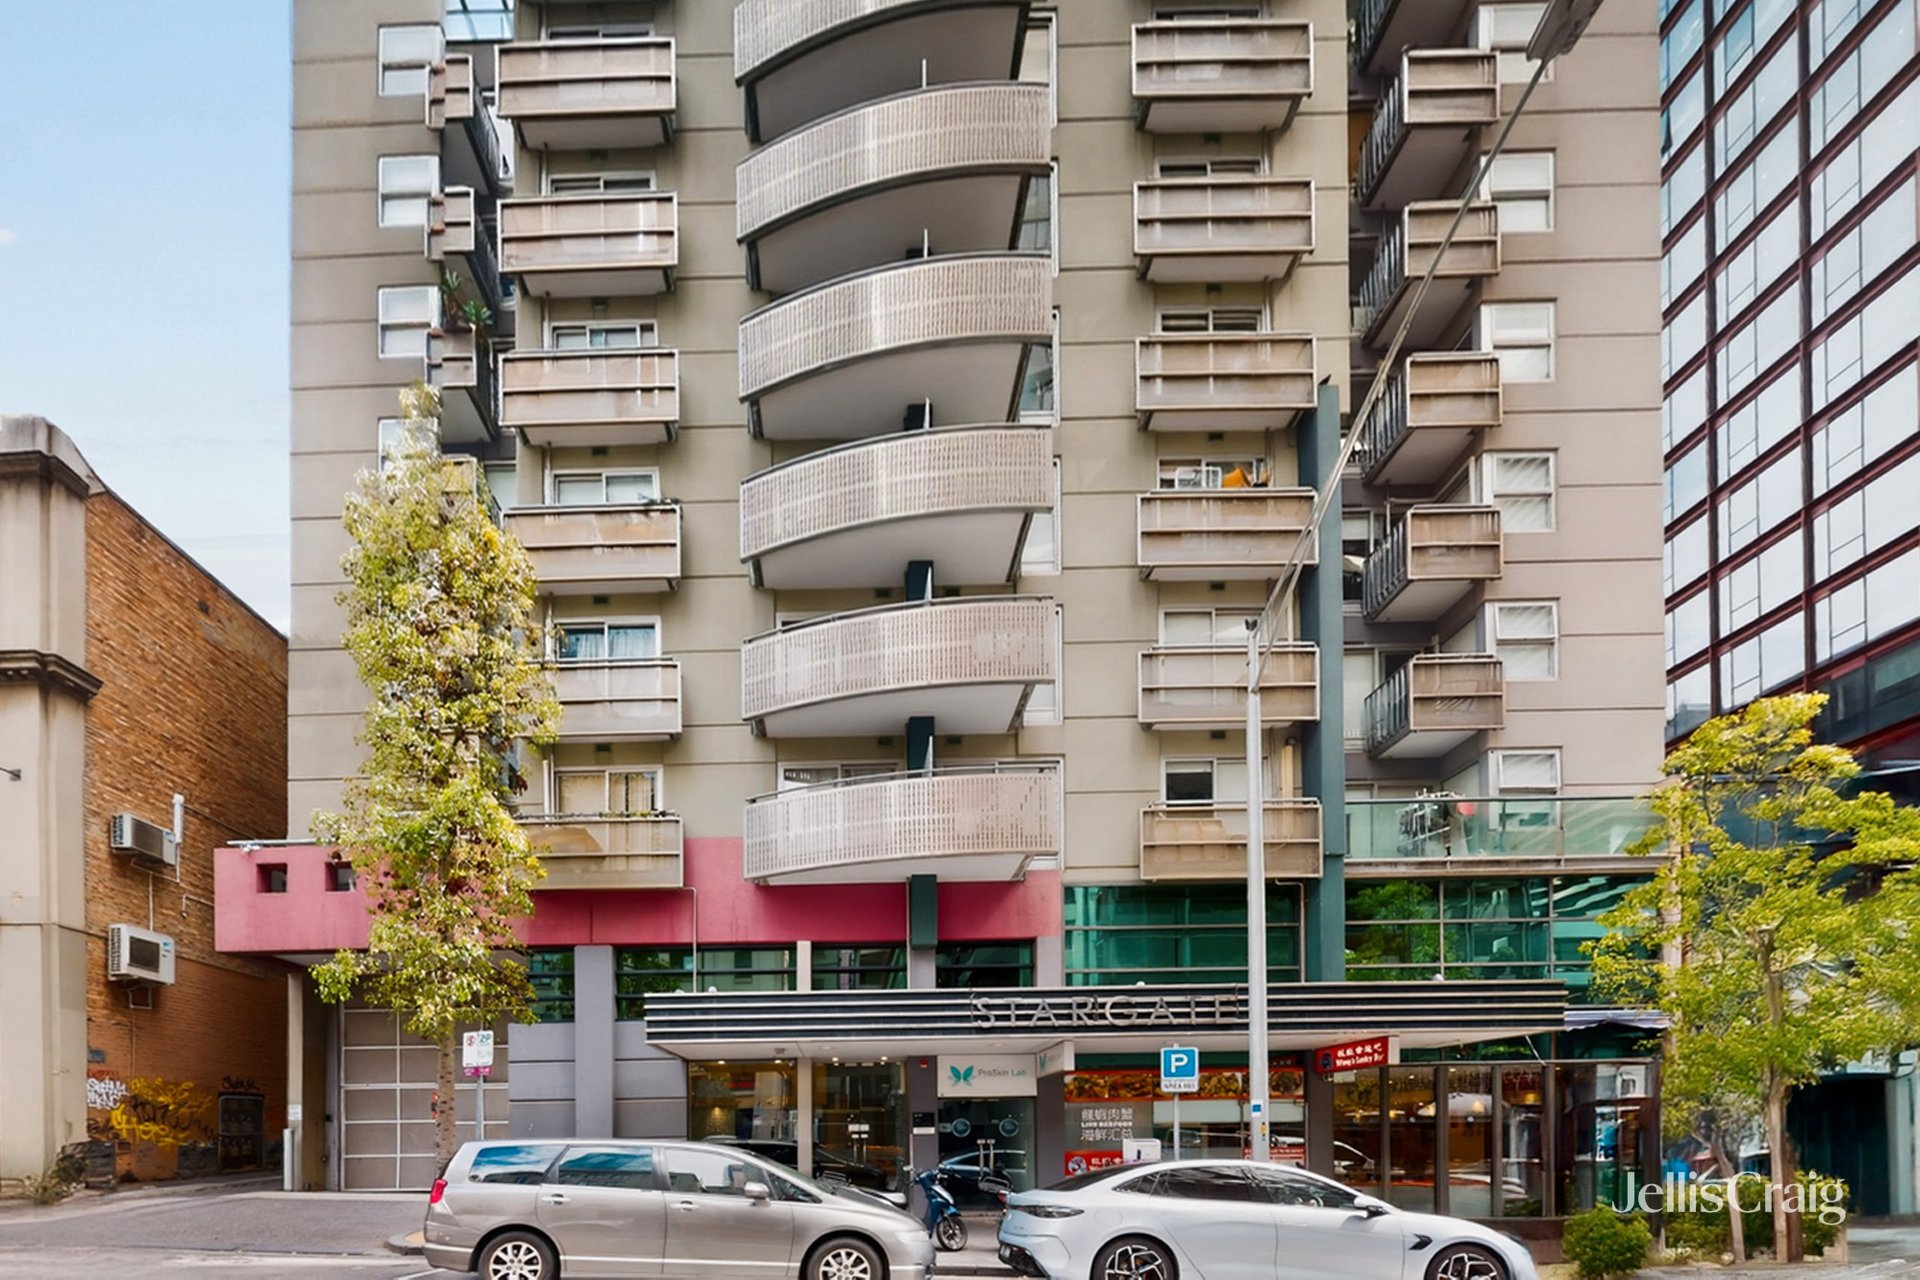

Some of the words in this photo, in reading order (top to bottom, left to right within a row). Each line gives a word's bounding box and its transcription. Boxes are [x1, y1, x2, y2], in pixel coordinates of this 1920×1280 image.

[976, 995, 1238, 1027] STARGATE
[1011, 1069, 1027, 1077] Lab
[1170, 1054, 1189, 1073] P
